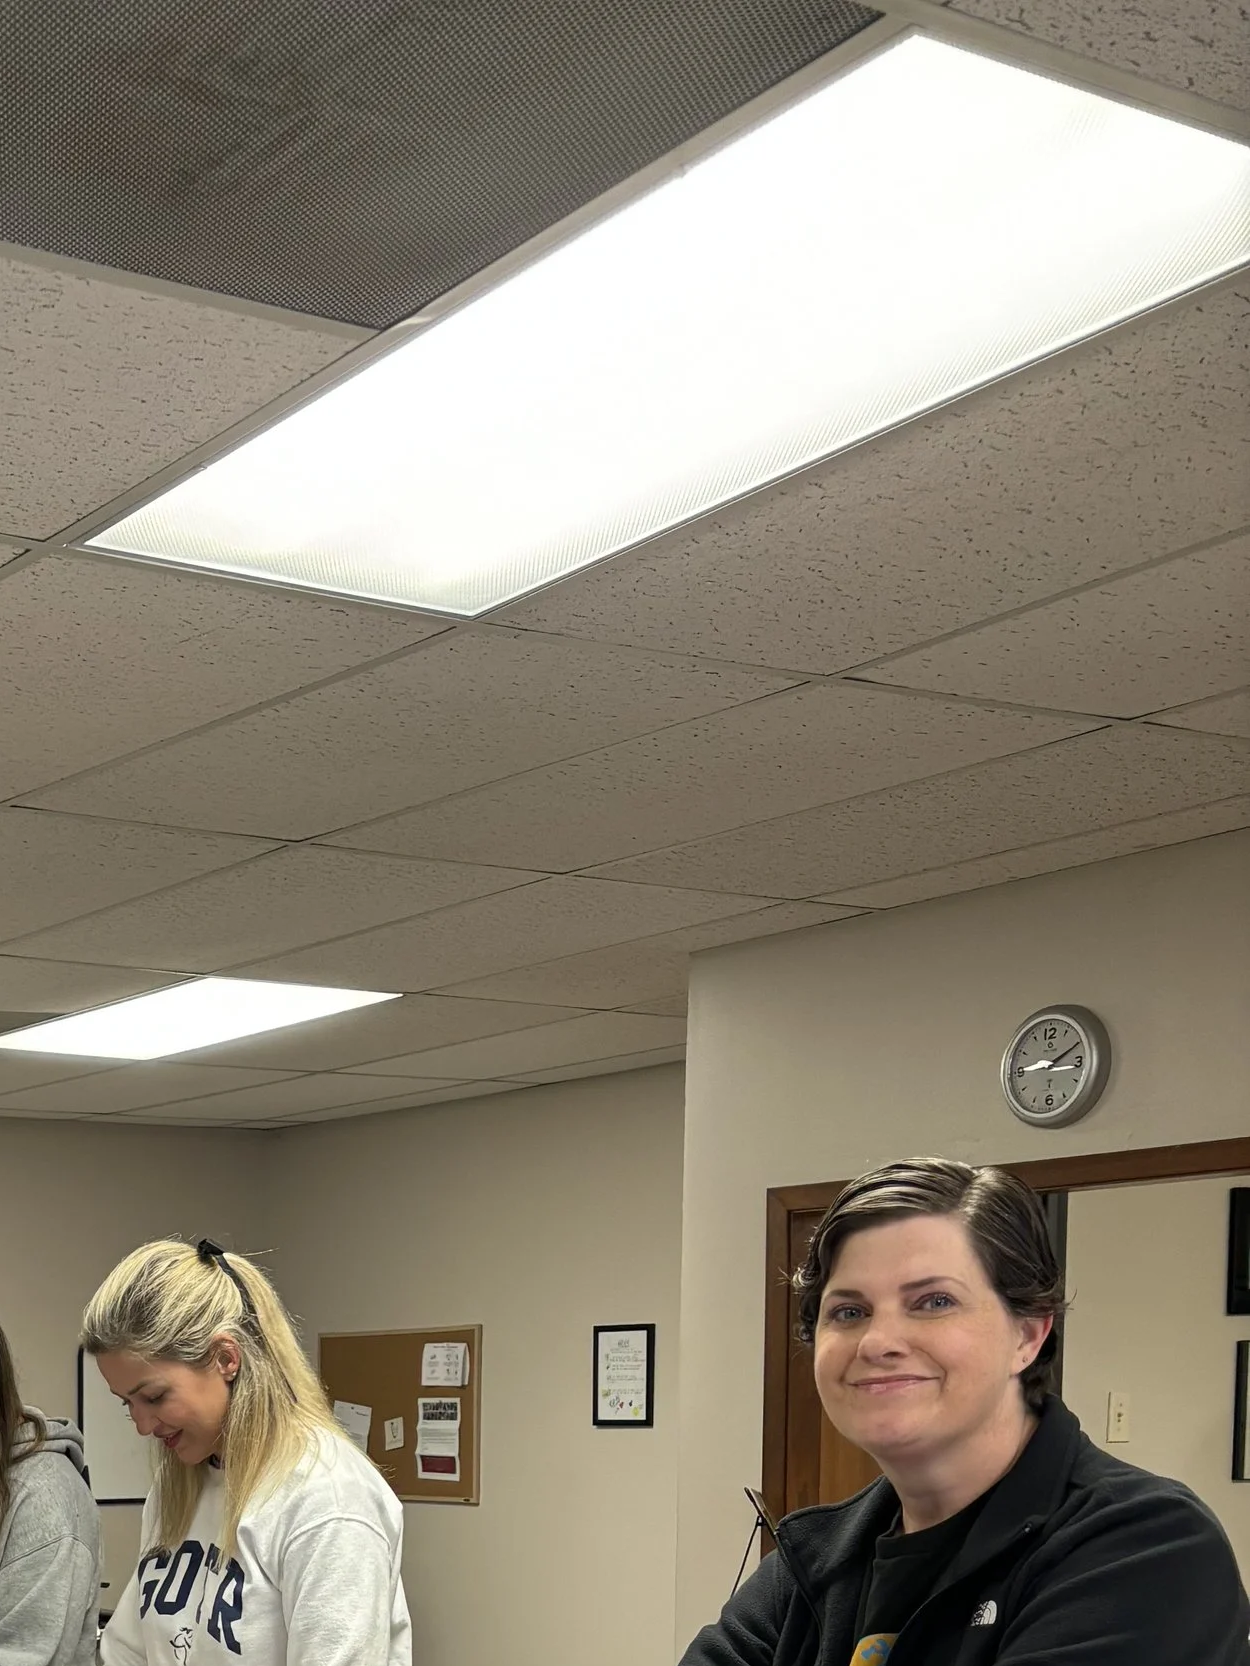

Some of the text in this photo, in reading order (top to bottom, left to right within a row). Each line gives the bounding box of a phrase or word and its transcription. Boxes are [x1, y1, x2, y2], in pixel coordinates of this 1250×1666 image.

[1044, 1027, 1057, 1041] 12
[1074, 1055, 1083, 1068] 3
[1017, 1066, 1025, 1078] 9
[1045, 1094, 1054, 1106] 6
